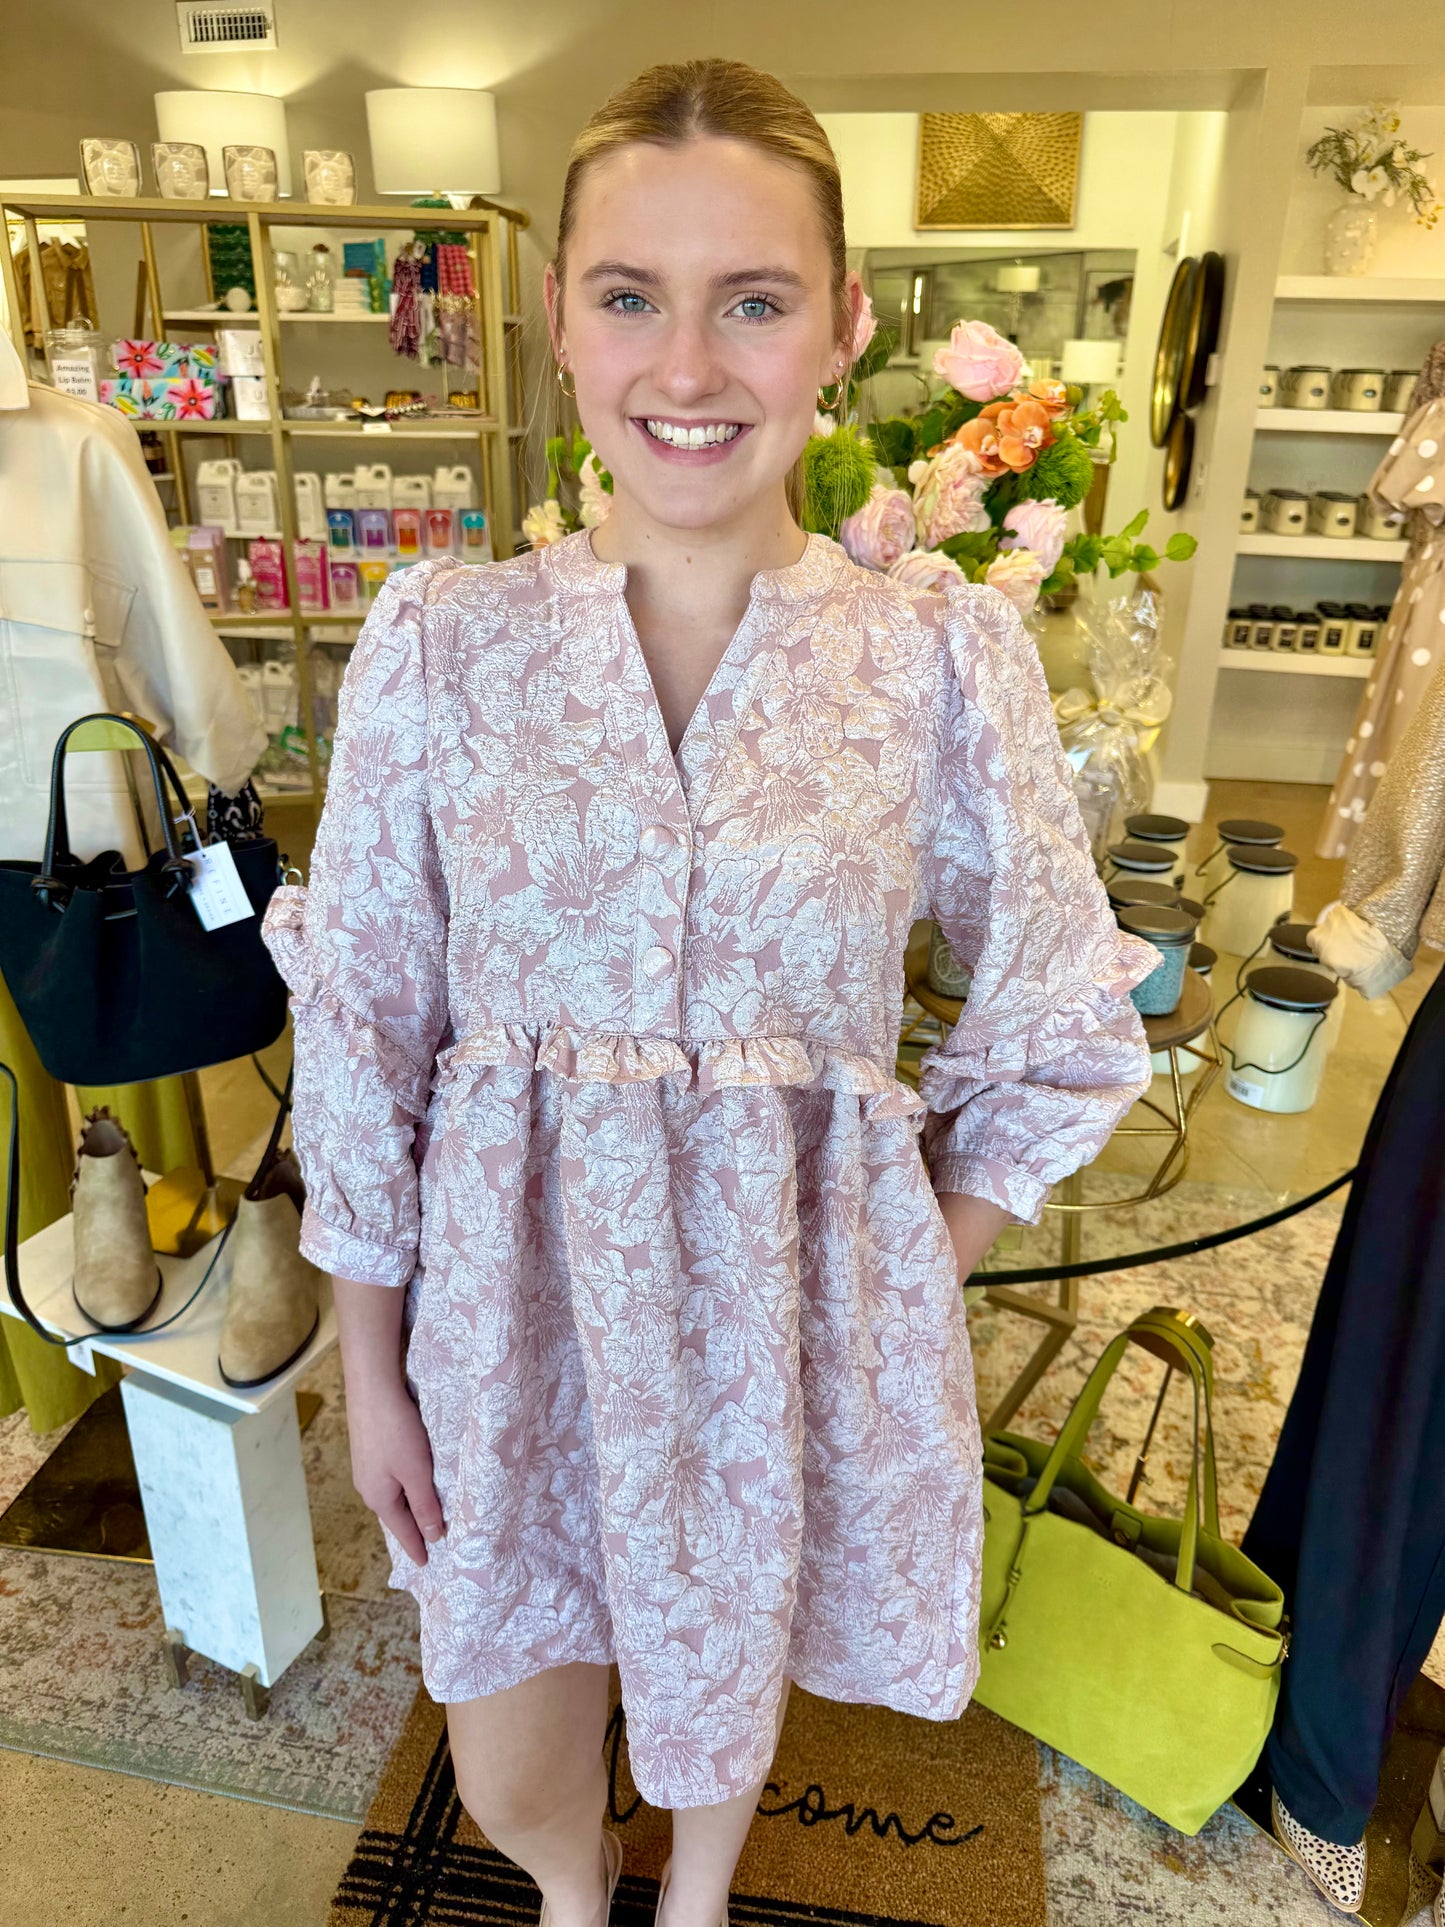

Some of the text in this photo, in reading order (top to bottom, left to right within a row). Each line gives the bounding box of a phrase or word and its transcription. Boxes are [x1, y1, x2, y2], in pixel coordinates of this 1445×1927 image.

[56, 364, 89, 373] Amazing
[58, 376, 92, 384] Lip Balm
